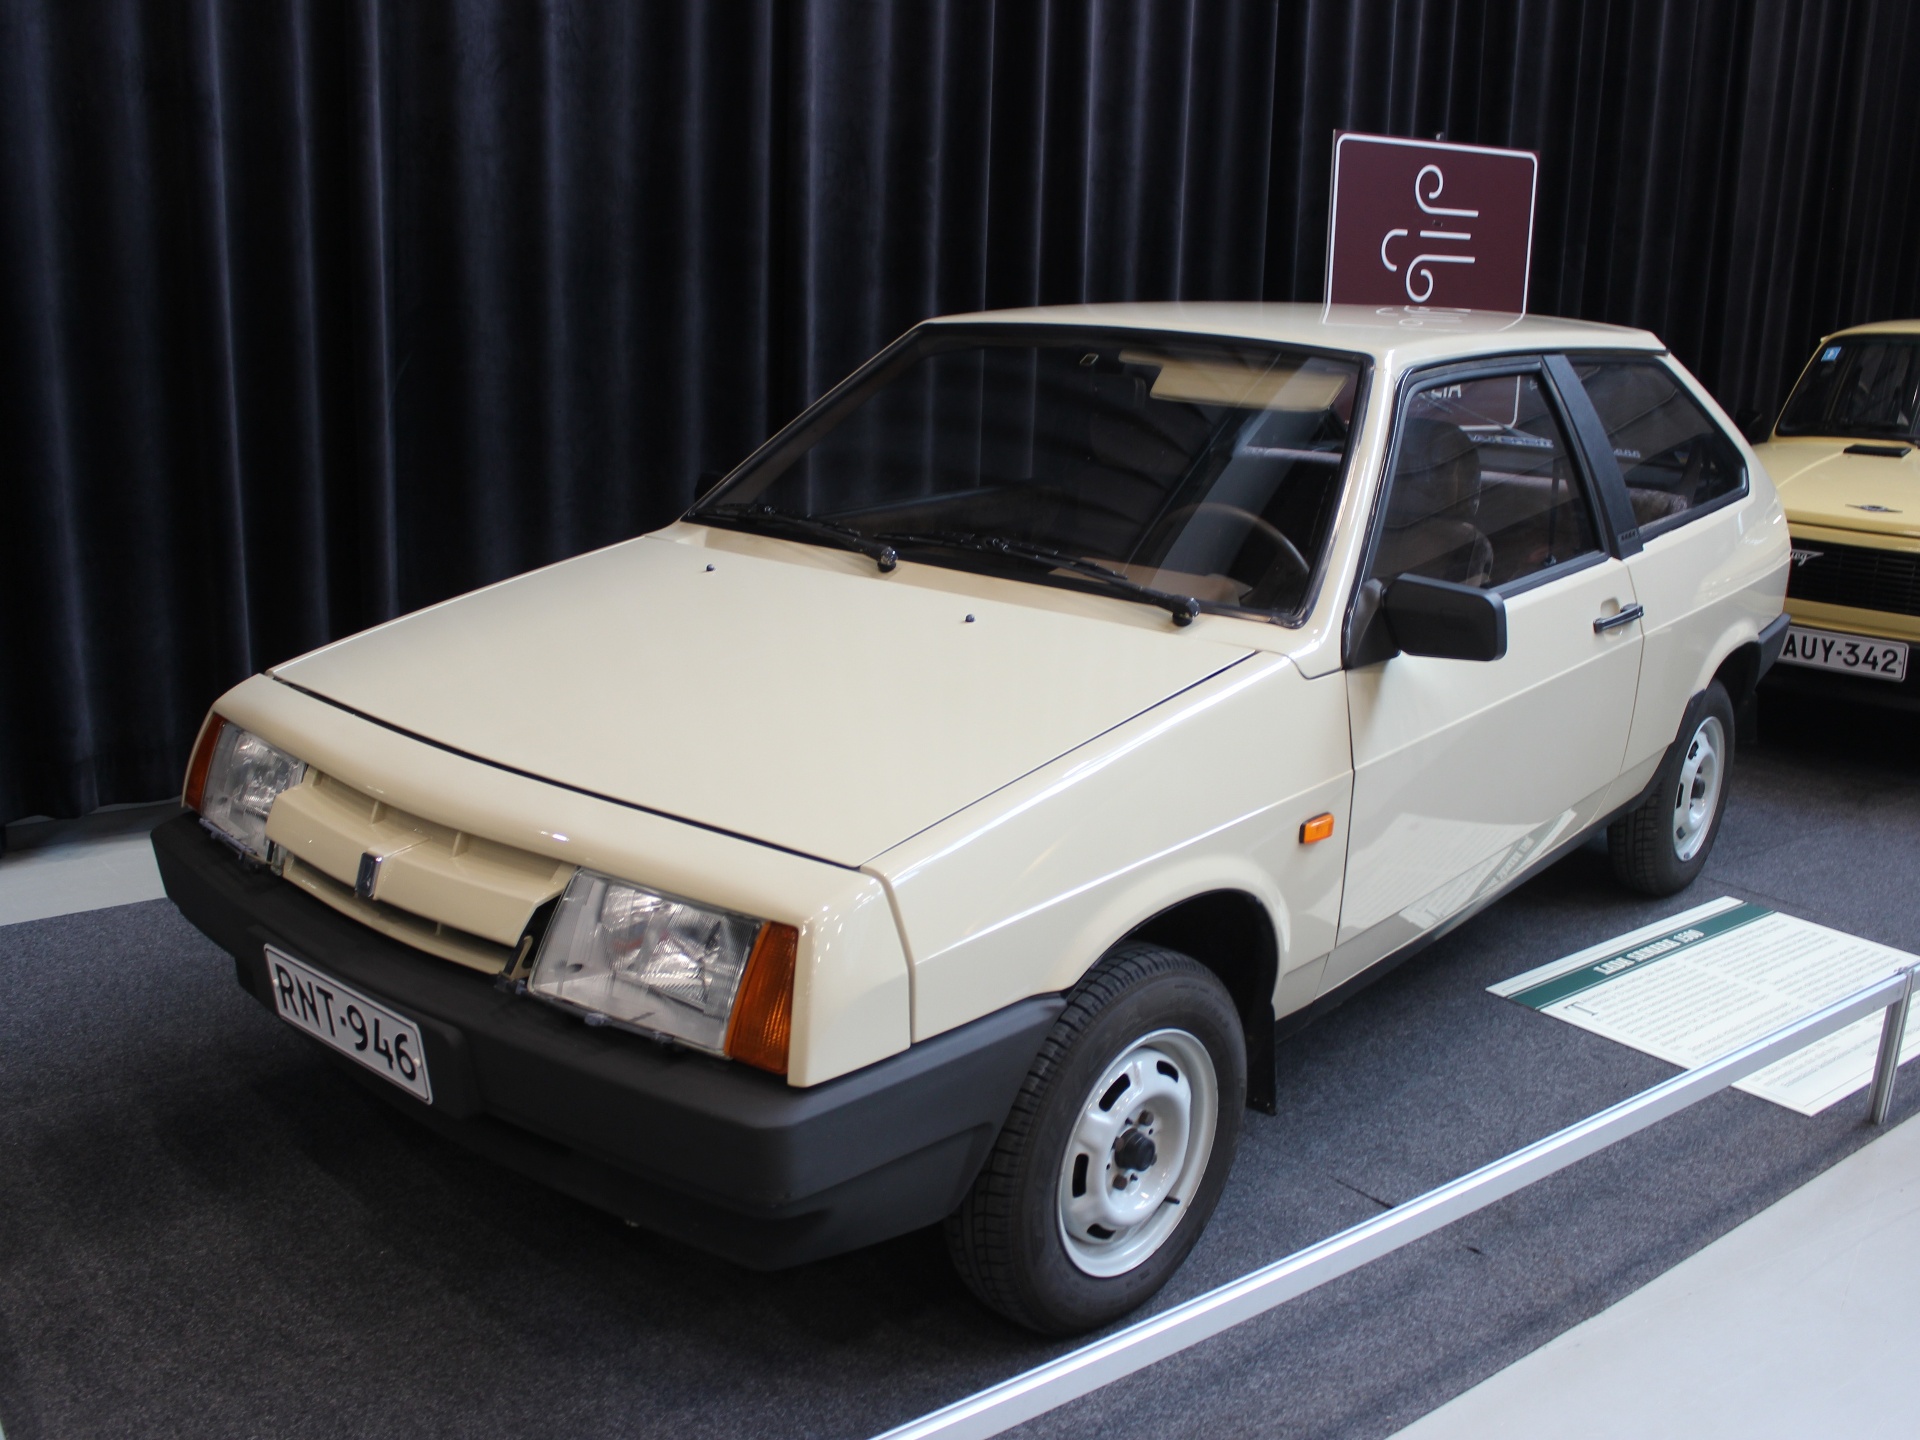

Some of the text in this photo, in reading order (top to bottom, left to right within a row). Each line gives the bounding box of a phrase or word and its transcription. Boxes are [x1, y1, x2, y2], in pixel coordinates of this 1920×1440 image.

[1783, 633, 1898, 674] AUY-342
[1593, 957, 1636, 975] LADA
[275, 963, 417, 1081] RNT-946
